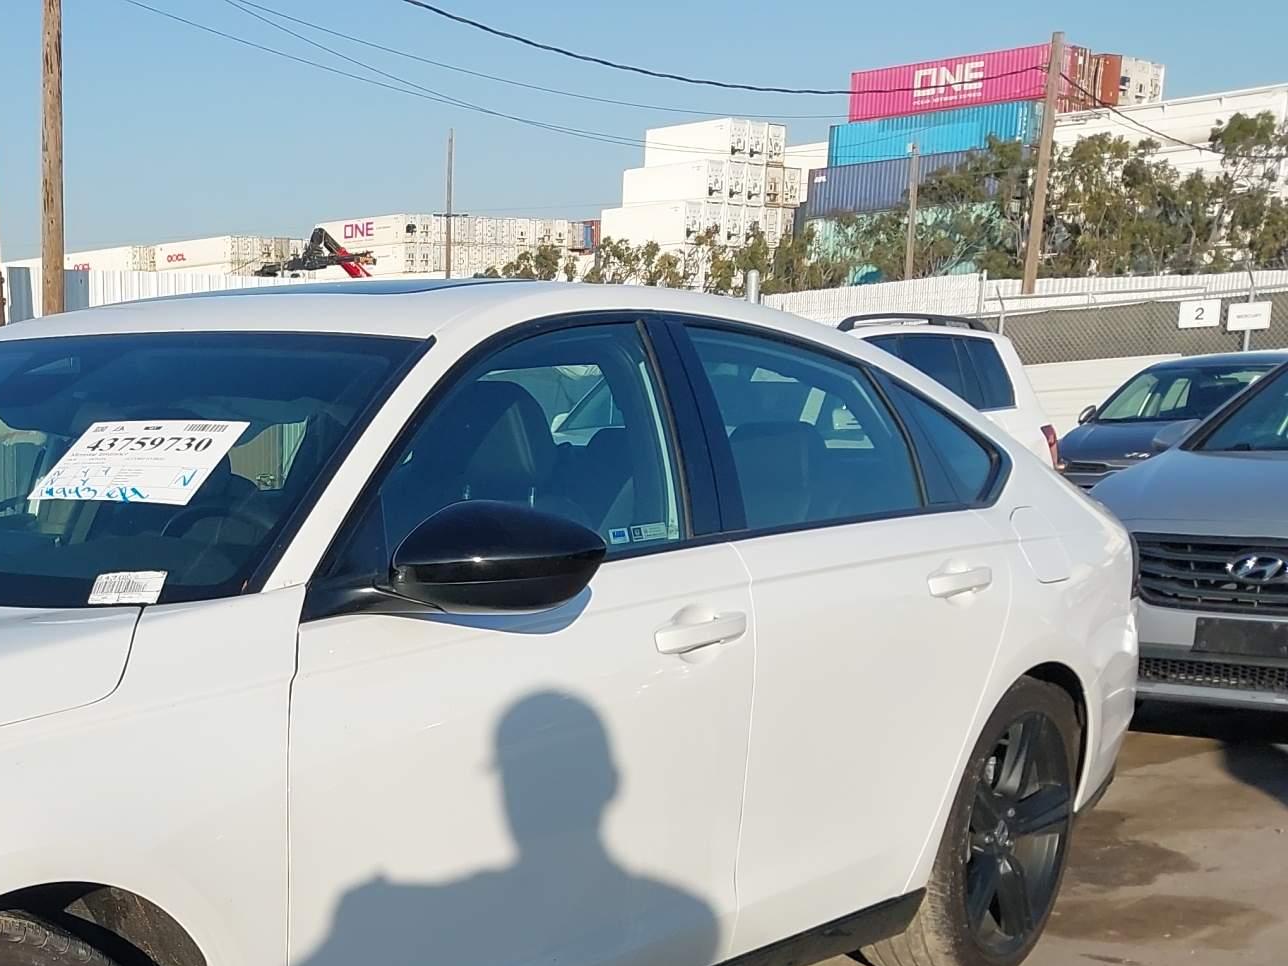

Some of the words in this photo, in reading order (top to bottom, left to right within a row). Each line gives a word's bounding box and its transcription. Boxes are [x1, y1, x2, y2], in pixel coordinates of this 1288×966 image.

[913, 61, 985, 97] ONE
[344, 221, 374, 239] ONE
[1195, 307, 1205, 320] 2
[86, 437, 213, 452] 43759730
